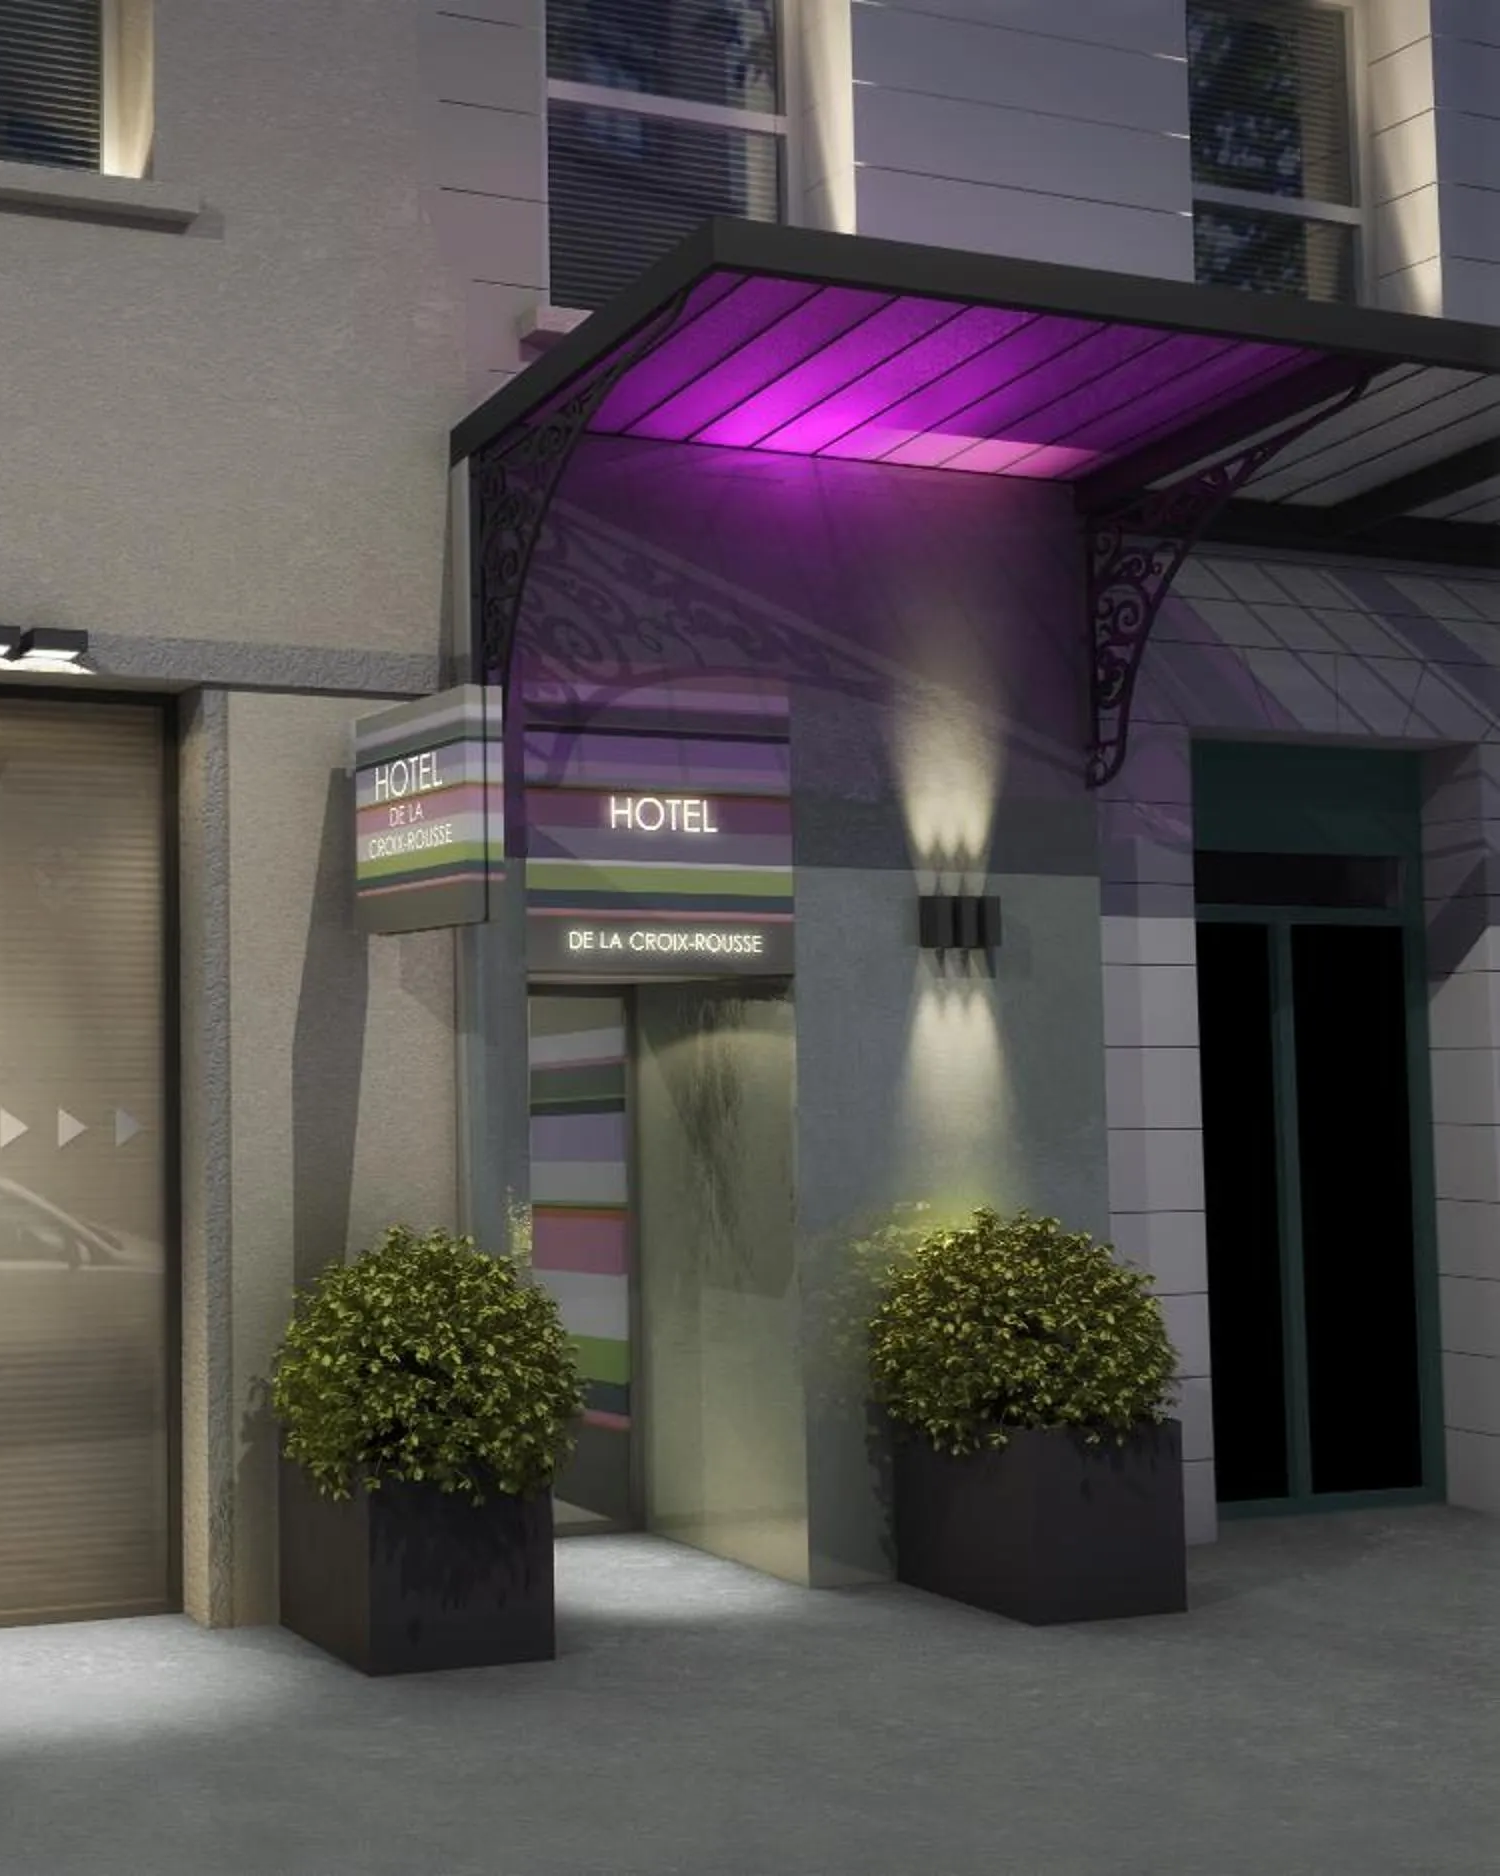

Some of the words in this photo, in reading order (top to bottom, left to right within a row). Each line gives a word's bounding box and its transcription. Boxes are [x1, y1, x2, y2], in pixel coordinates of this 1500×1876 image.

[374, 751, 443, 801] HOTEL
[388, 805, 406, 828] DE
[408, 801, 425, 824] LA
[610, 796, 719, 833] HOTEL
[368, 823, 453, 859] CROIX-ROUSSE
[568, 931, 595, 949] DE
[600, 931, 623, 949] LA
[629, 931, 764, 953] CROIX-ROUSSE
